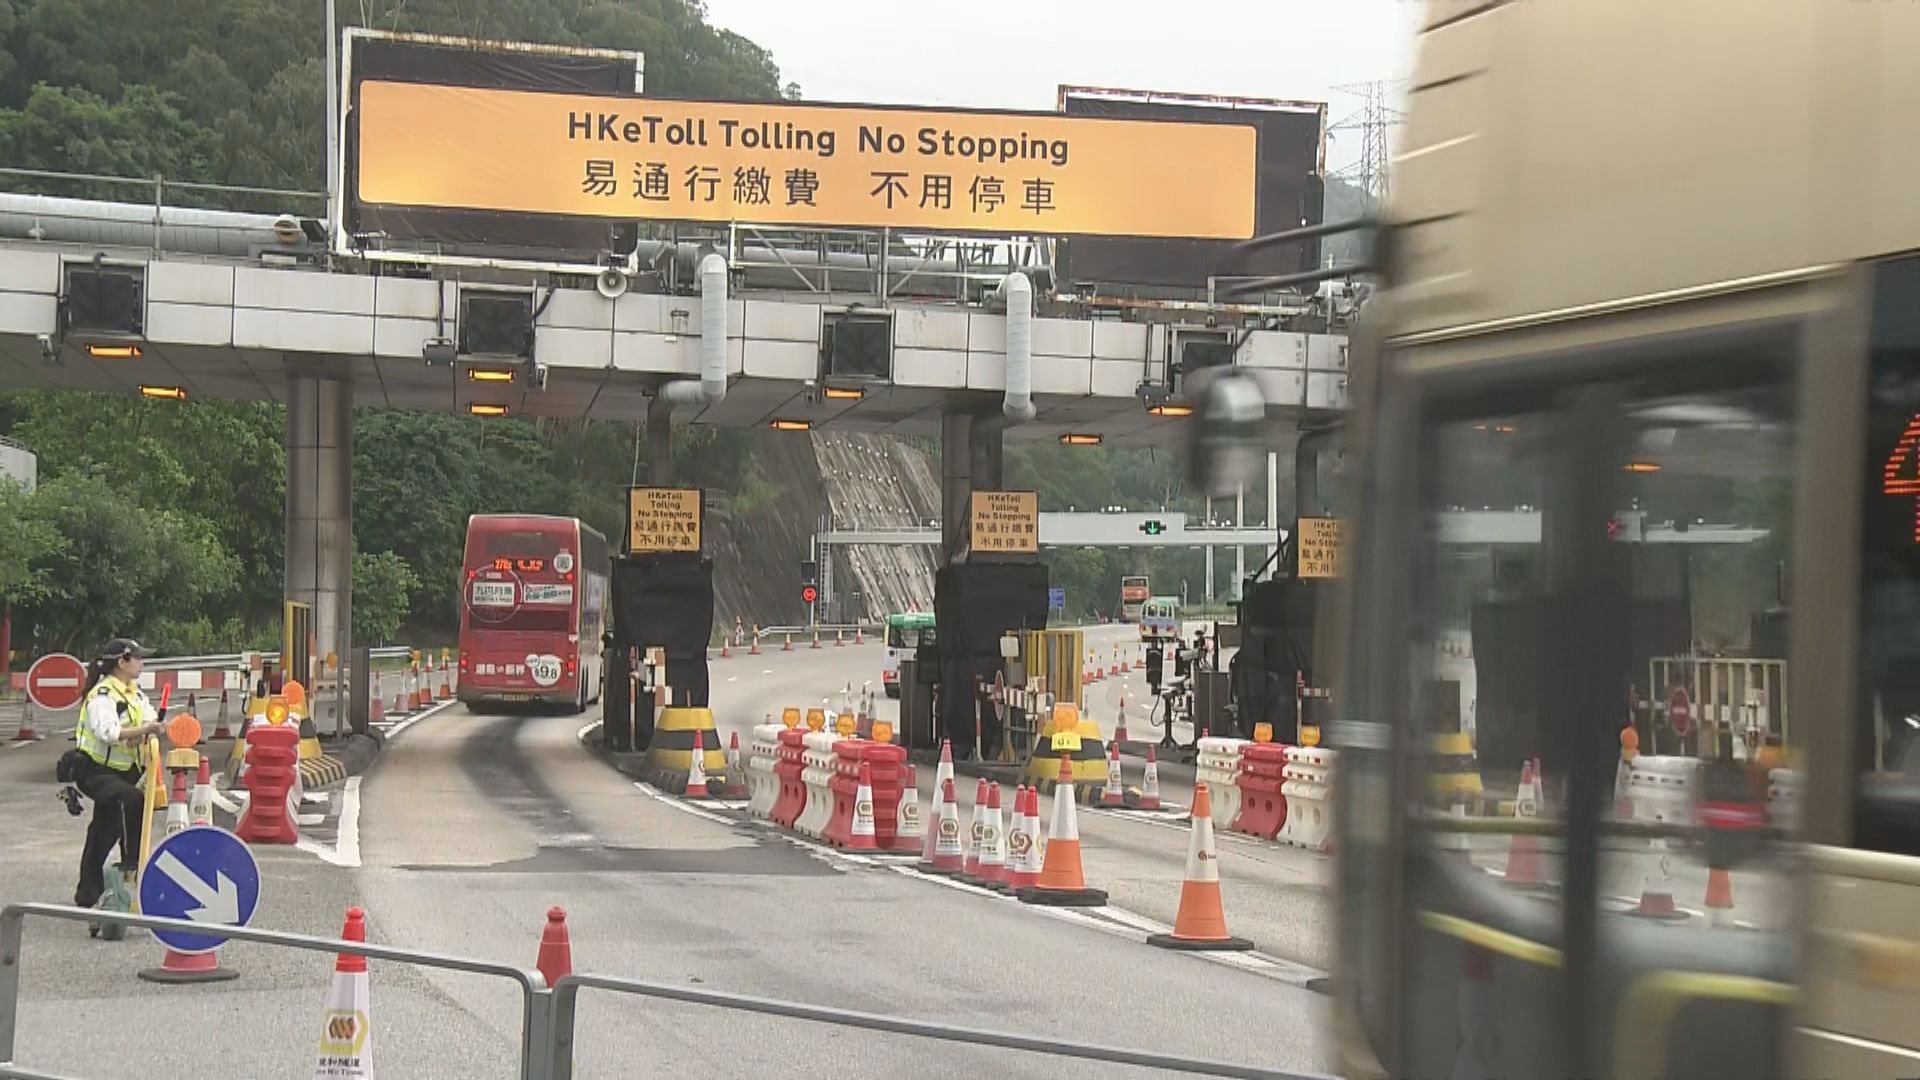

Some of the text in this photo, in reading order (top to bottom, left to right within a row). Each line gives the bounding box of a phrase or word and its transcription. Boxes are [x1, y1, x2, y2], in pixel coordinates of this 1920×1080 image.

[568, 112, 1068, 166] HKeToll Tolling No Stopping
[582, 160, 1056, 215] 易通行繳費 不用停車
[987, 494, 1021, 503] HKeToll
[651, 501, 681, 509] Tolling
[991, 503, 1019, 512] Tolling
[653, 511, 693, 519] Stopping
[978, 512, 1031, 521] No Stopping
[1313, 521, 1337, 529] HKeT
[1302, 548, 1335, 561] 易通行
